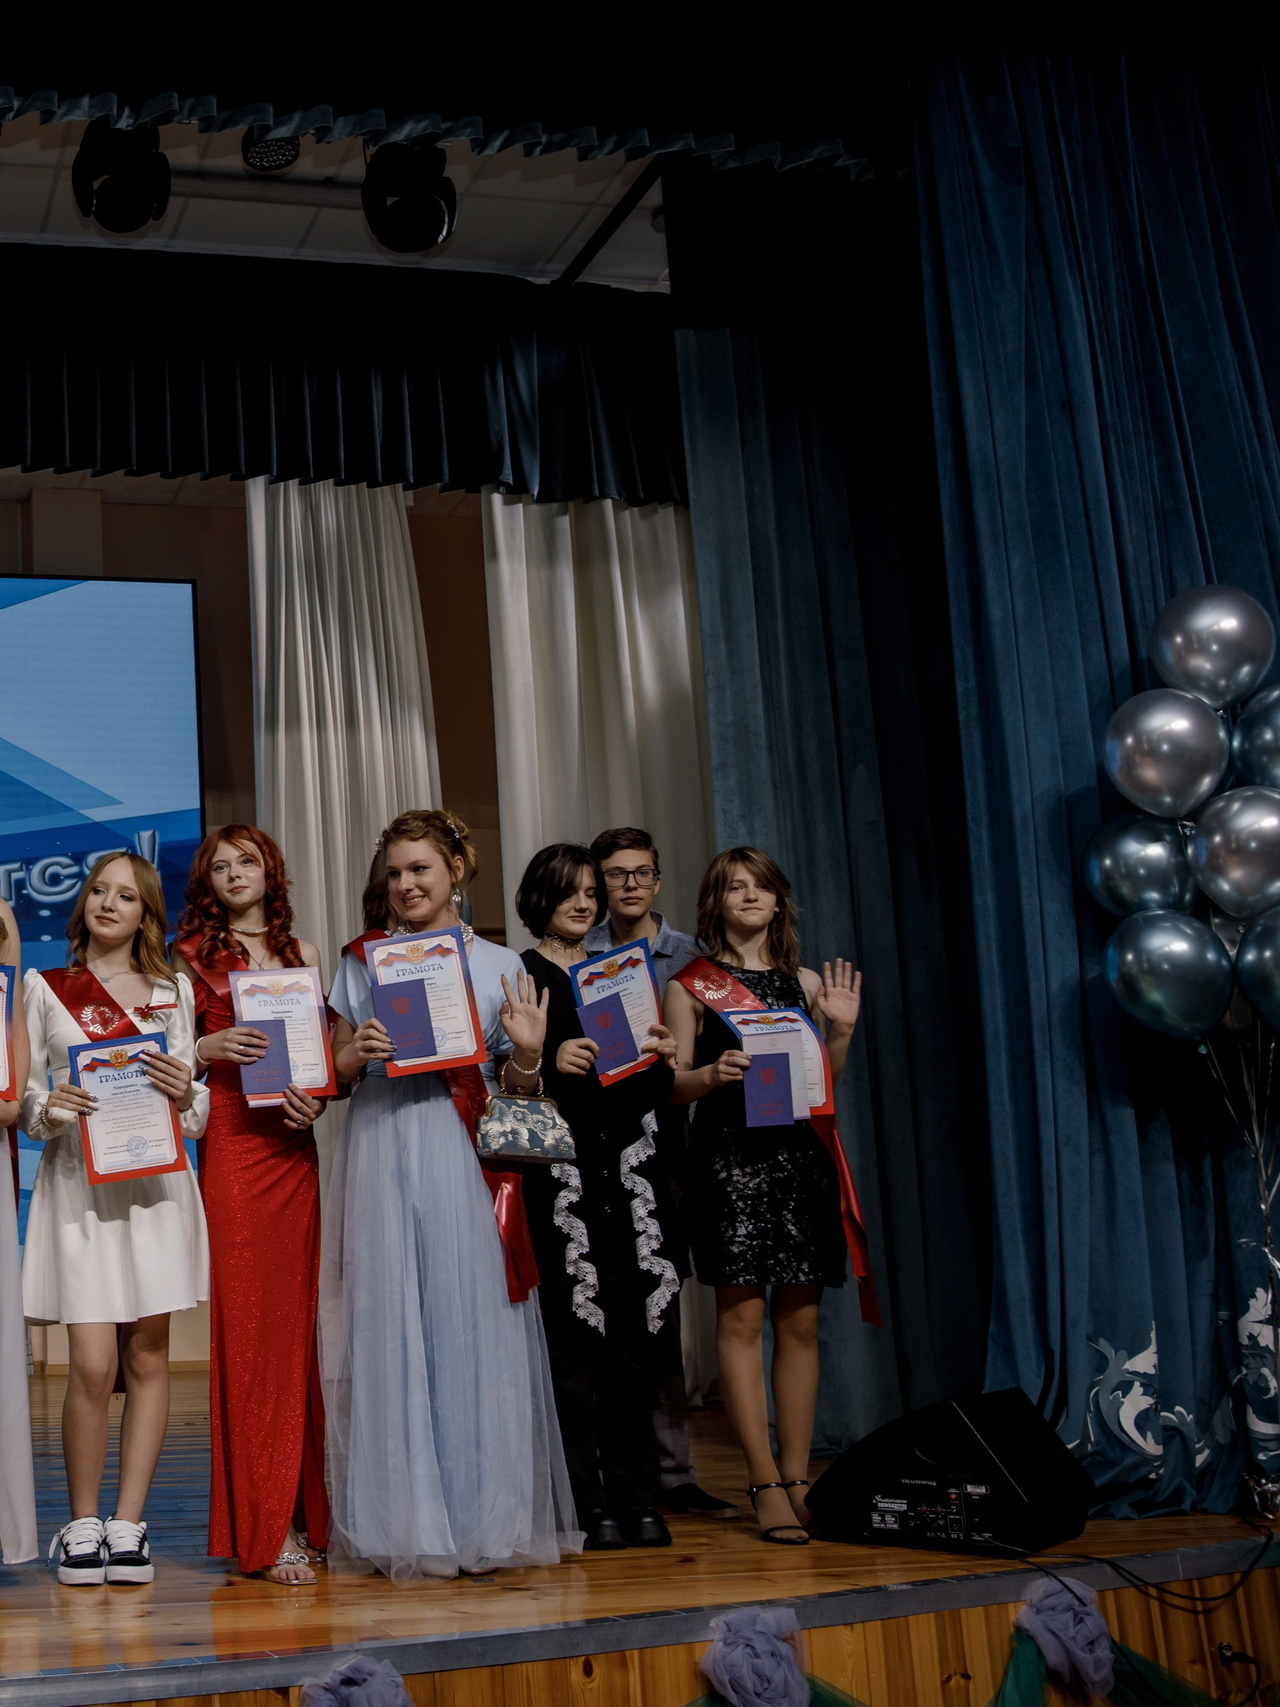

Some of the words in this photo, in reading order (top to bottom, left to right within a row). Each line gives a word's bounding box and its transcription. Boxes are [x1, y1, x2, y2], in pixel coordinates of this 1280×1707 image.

[396, 963, 444, 977] ГРАМОТА
[596, 974, 635, 994] ГРАМОТА
[257, 997, 302, 1008] ГРАМОТА
